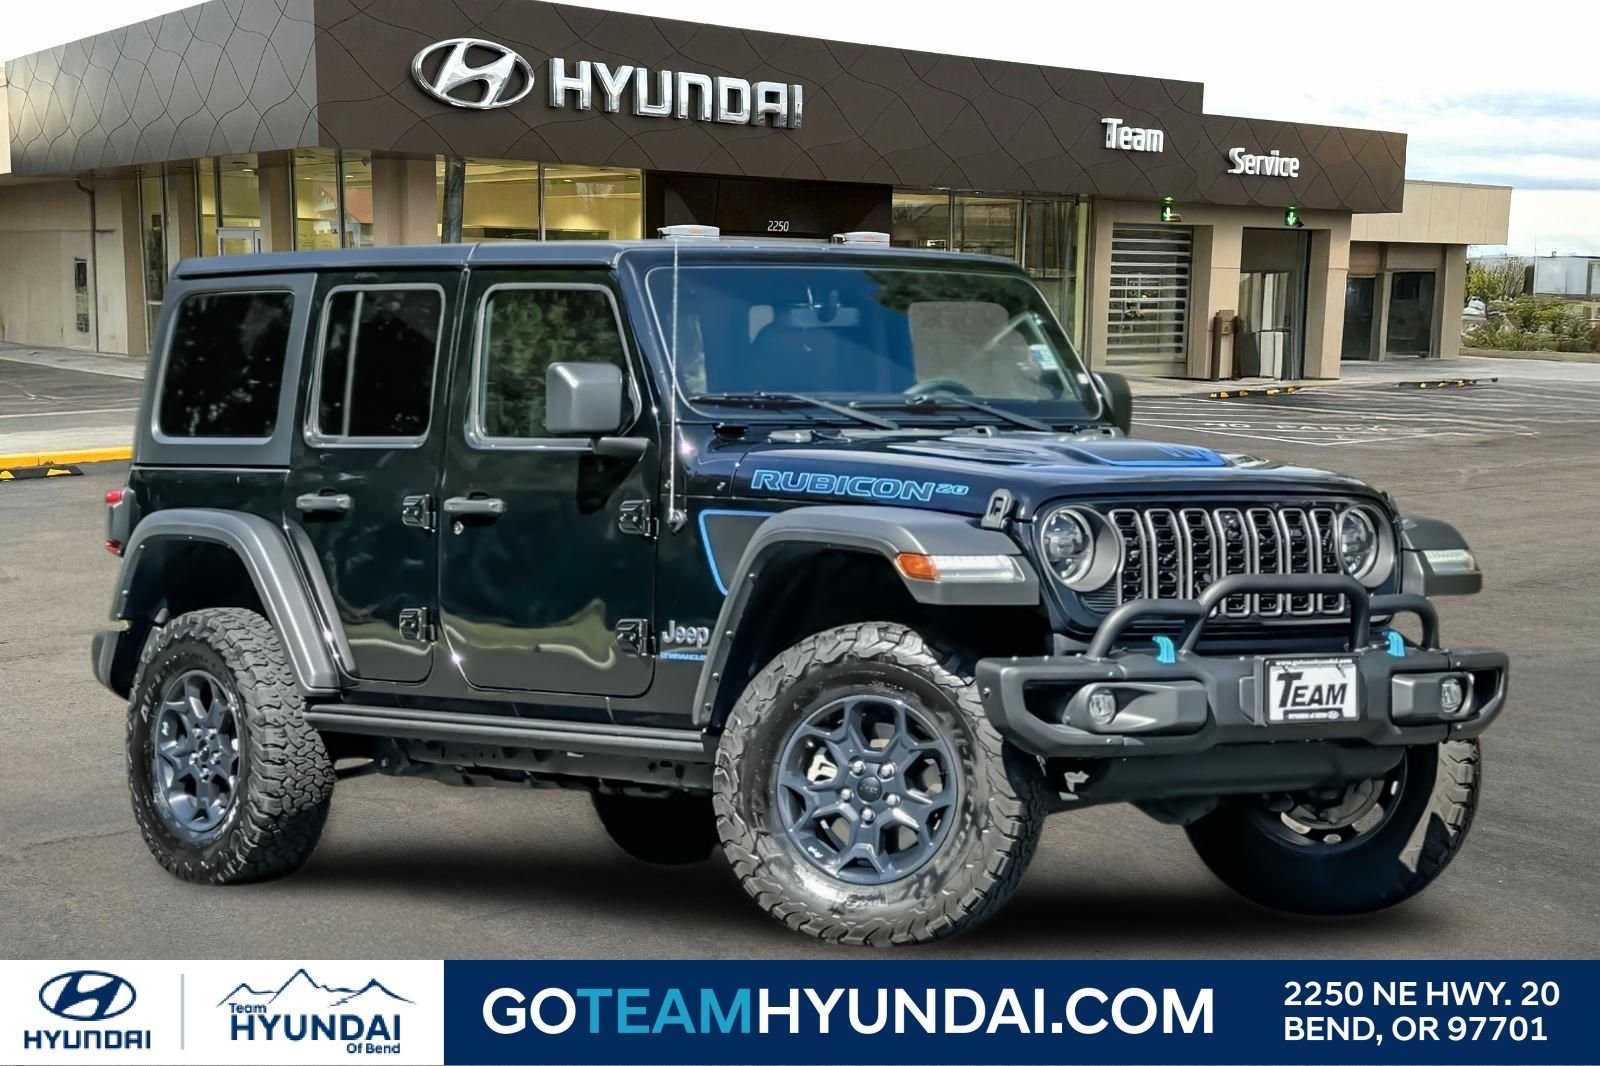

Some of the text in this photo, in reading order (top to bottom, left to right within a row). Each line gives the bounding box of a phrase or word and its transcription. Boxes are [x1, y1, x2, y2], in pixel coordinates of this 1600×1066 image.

[548, 56, 803, 130] HYUNDAI
[1101, 117, 1165, 153] Team
[1227, 147, 1300, 178] Service
[767, 220, 790, 232] 2250
[751, 469, 936, 502] RUBICON
[661, 620, 710, 649] Jeep
[1276, 671, 1348, 709] TEAM
